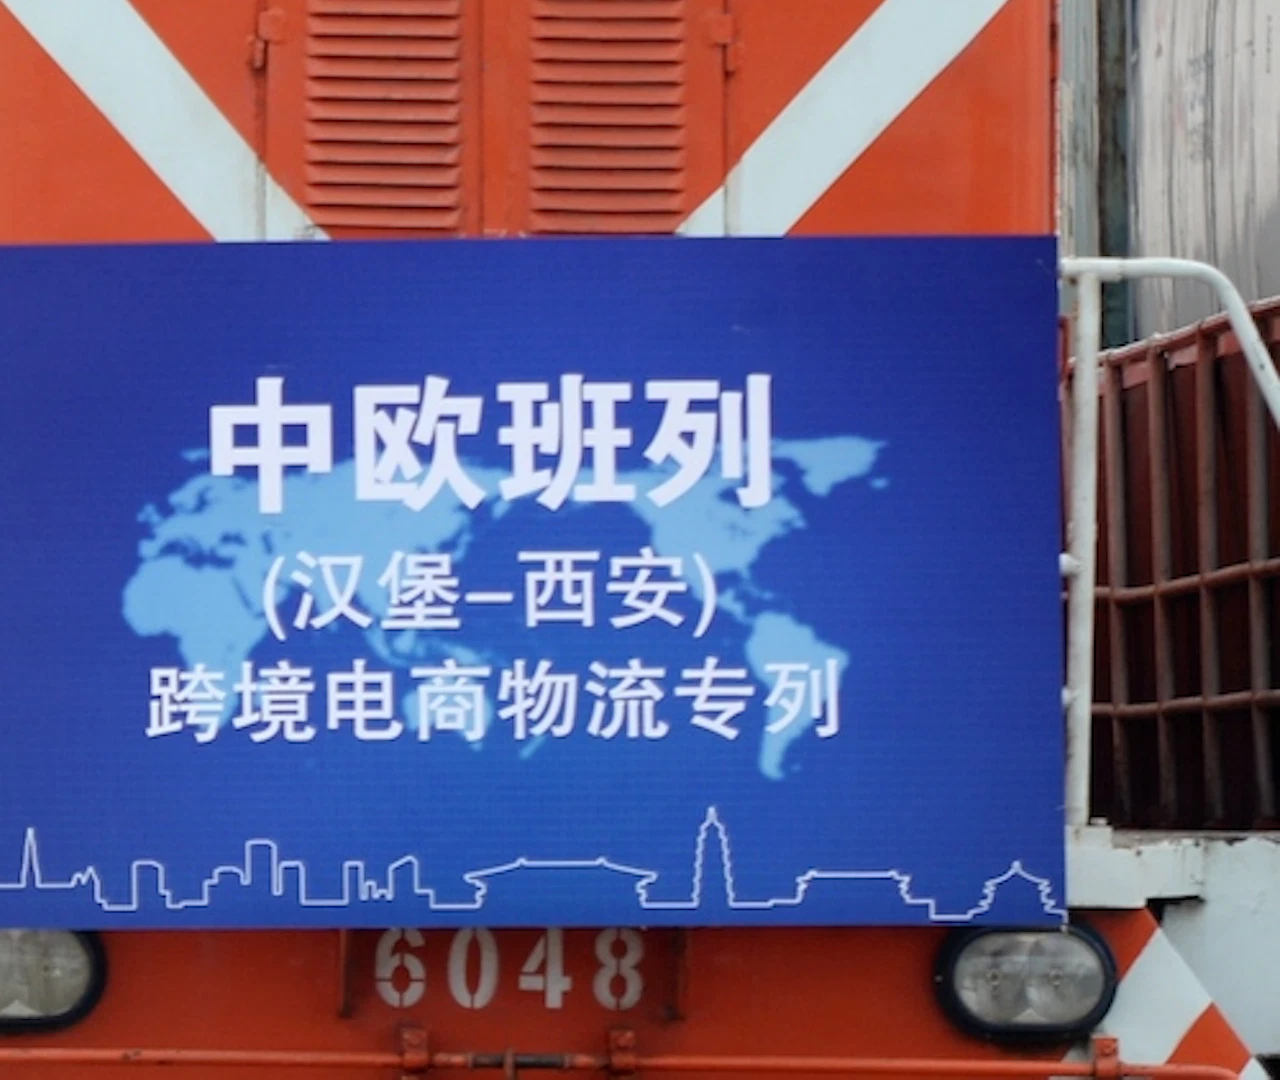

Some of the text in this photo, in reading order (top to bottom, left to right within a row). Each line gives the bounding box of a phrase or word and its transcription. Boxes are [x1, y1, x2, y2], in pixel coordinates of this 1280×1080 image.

[210, 373, 772, 515] 中欧班列
[145, 656, 839, 743] 跨境电商物流专列
[375, 927, 643, 1010] 6048
